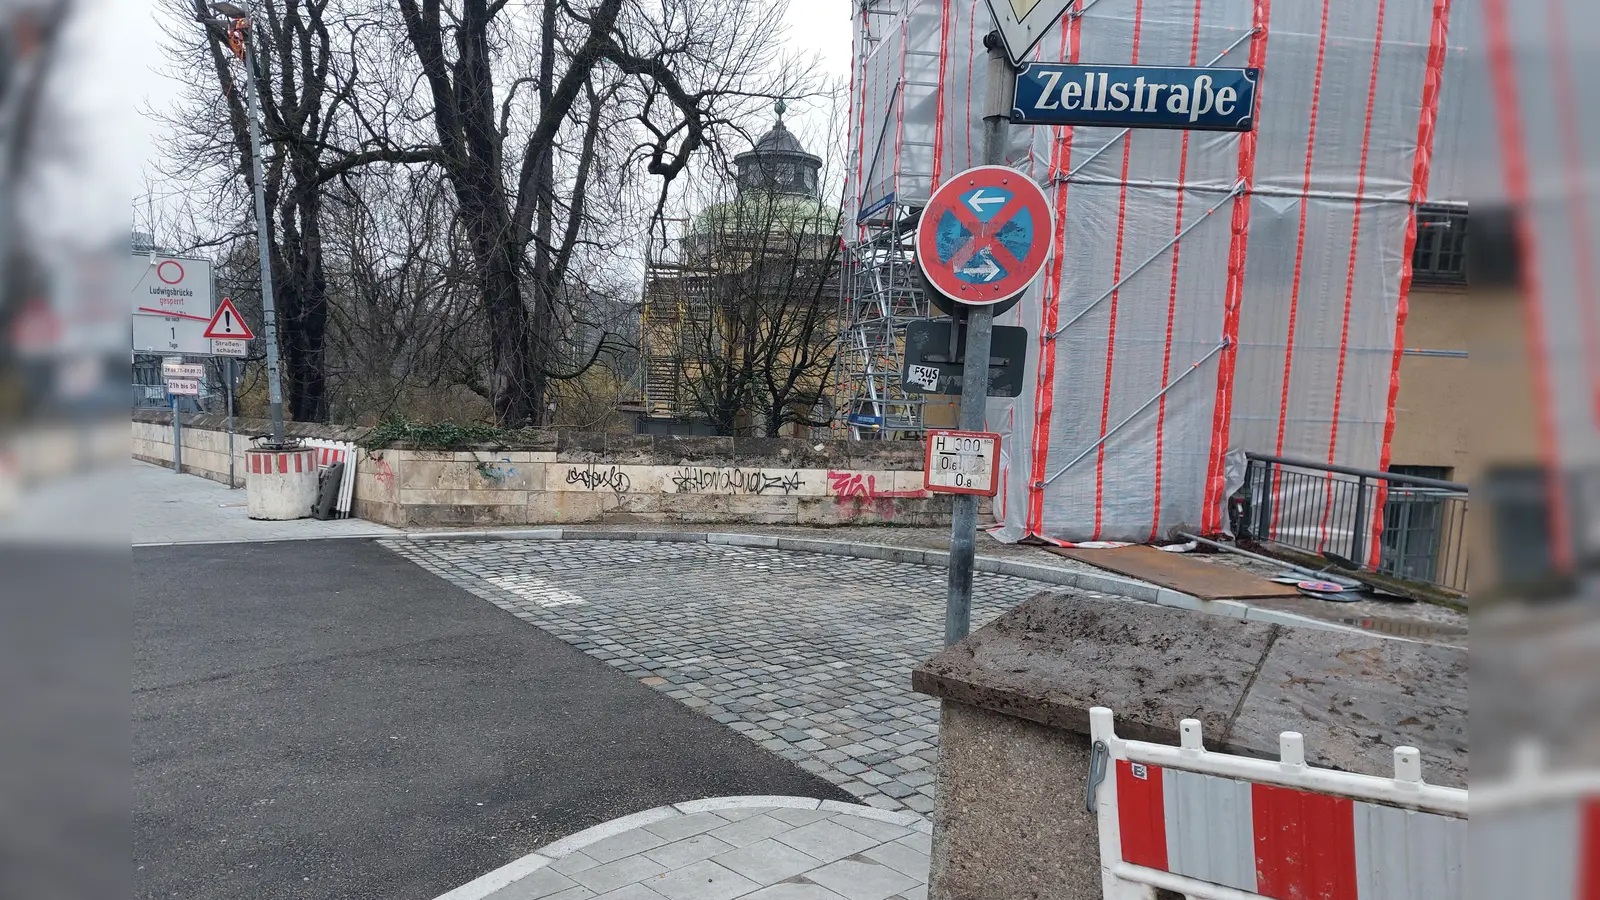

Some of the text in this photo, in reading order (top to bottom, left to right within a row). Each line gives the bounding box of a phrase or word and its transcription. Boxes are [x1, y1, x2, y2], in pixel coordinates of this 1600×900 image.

[1033, 70, 1238, 123] Zellstraße
[149, 286, 193, 297] Ludwigsbrücke
[159, 297, 184, 306] gesperrt
[170, 327, 175, 339] 1
[936, 436, 981, 451] H 300
